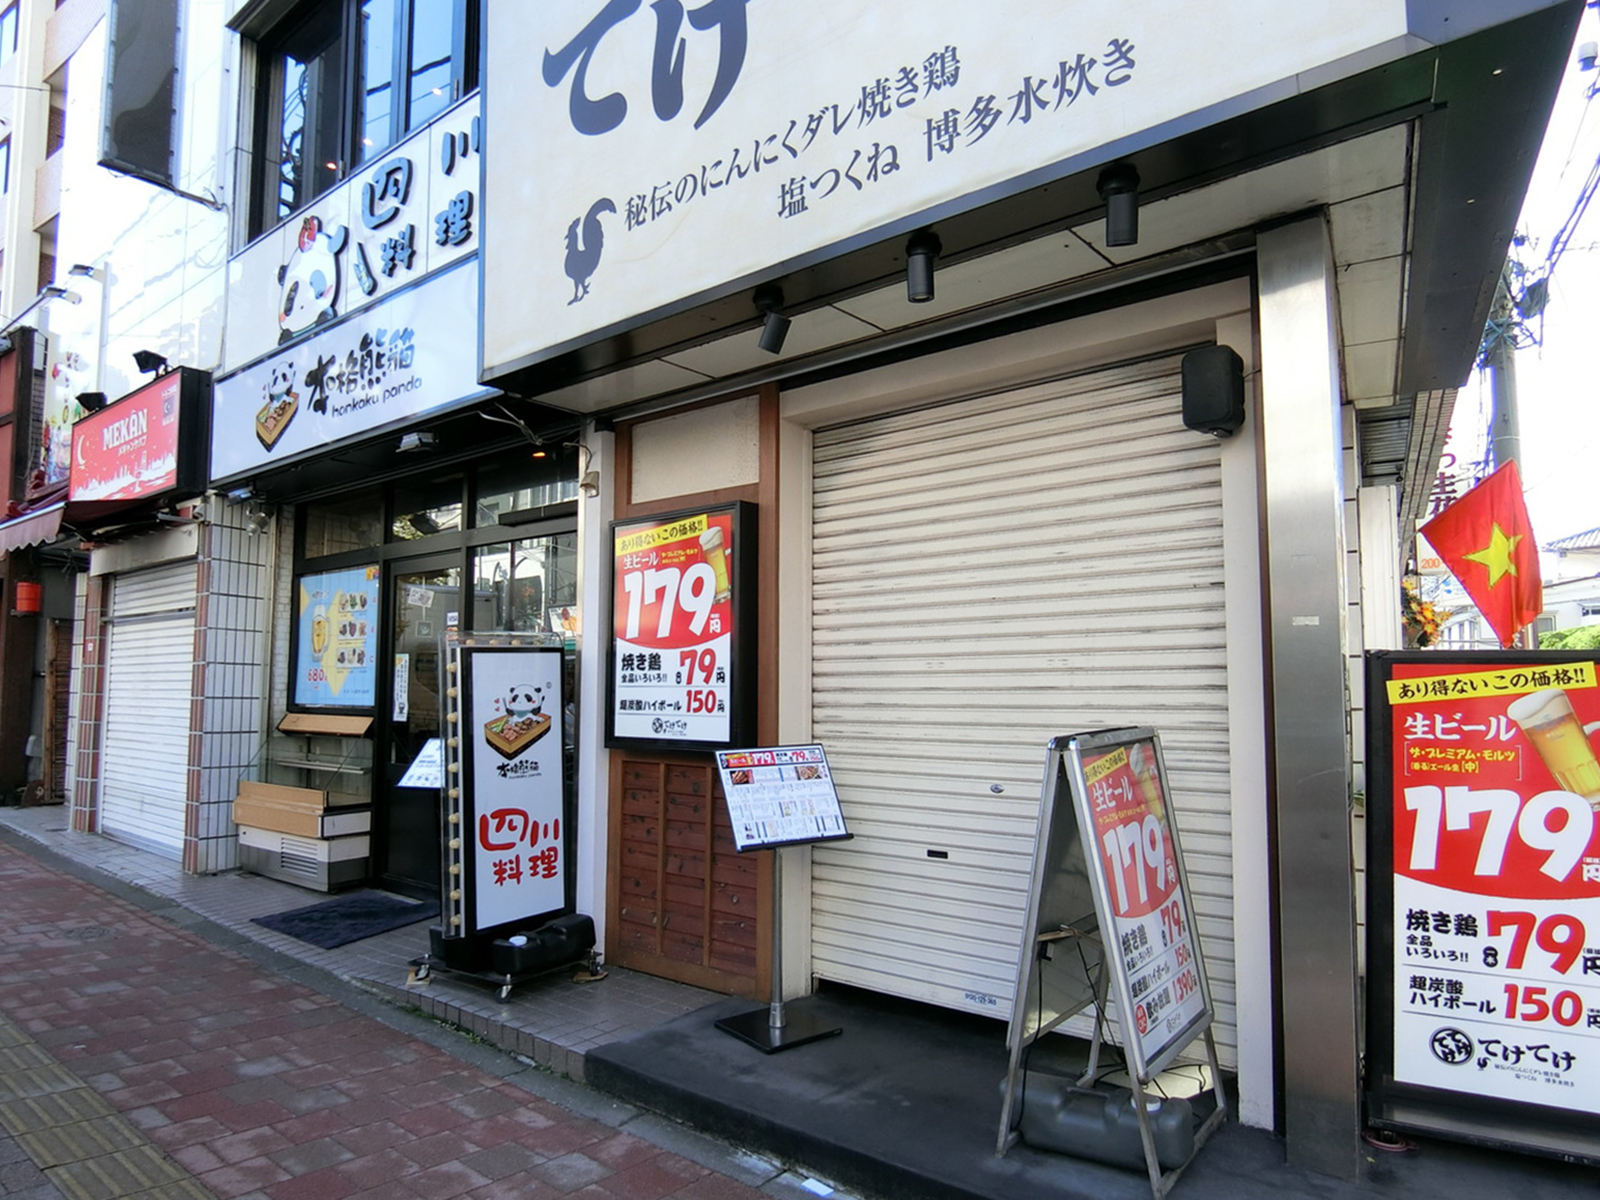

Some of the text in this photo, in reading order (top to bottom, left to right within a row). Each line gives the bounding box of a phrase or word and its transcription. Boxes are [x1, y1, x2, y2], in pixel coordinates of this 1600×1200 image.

[624, 45, 961, 232] 秘伝のにんにくダレ焼き鶏
[776, 37, 1137, 219] 塩つくね 博多水炊き
[382, 375, 423, 403] panda
[1398, 667, 1587, 700] あり得ないこの価格!!
[1403, 712, 1517, 742] 生ビール
[1409, 747, 1516, 763] ザ・プレミアム・モルツ
[1092, 776, 1133, 812] 生ビール
[479, 808, 560, 852] 四川
[492, 846, 560, 886] 料理
[1405, 908, 1478, 938] 焼き鶏
[1405, 934, 1433, 947] 全品
[1409, 974, 1464, 996] 超炭酸
[1409, 992, 1497, 1015] ハイボール
[1477, 1038, 1577, 1073] てけてけ
